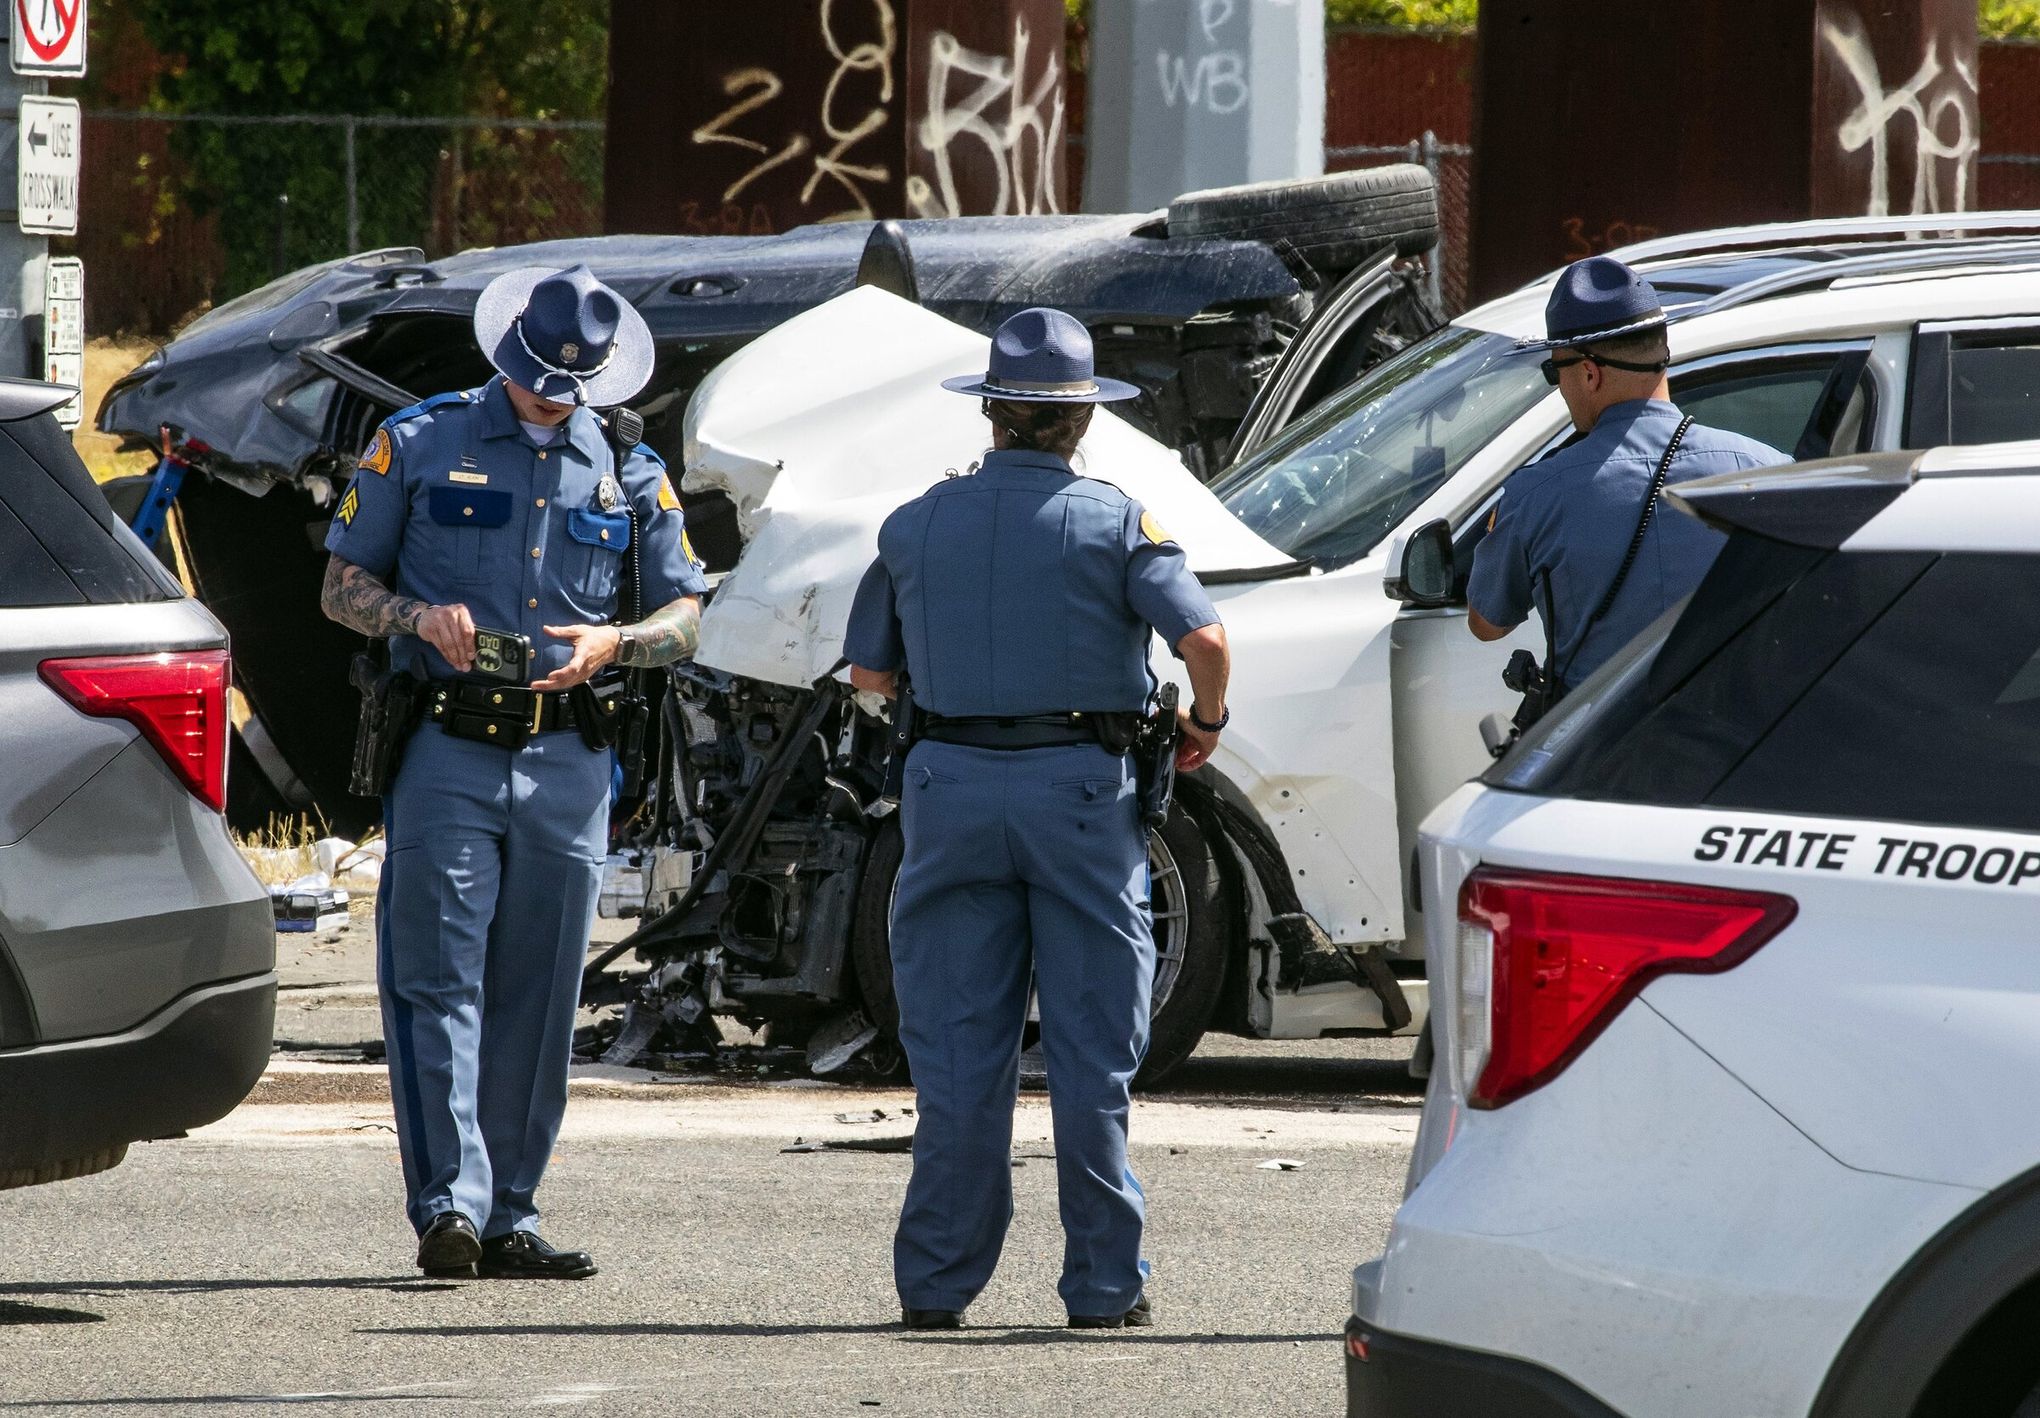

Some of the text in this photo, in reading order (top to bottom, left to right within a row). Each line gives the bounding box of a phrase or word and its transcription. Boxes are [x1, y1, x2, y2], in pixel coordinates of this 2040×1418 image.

[1156, 50, 1248, 114] WB
[52, 122, 72, 158] USE
[23, 171, 75, 210] CROSSWALK
[1693, 825, 1856, 871] STATE
